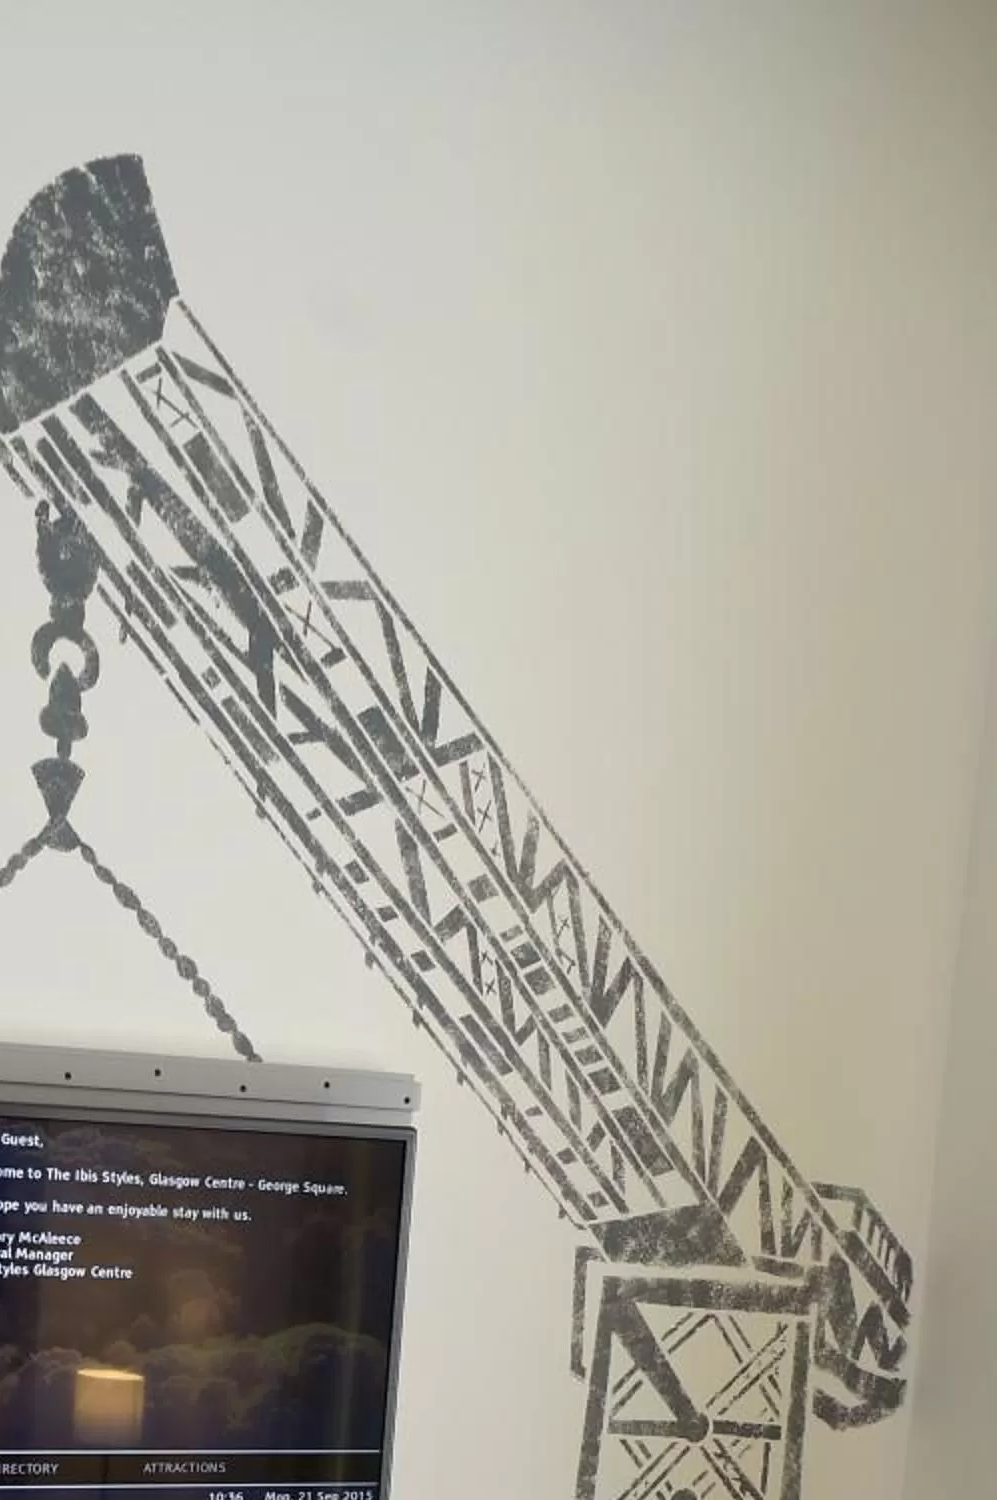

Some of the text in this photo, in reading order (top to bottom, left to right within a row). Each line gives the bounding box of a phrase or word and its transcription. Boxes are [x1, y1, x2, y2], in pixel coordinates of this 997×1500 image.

[1, 1133, 44, 1149] Guest,
[27, 1166, 42, 1180] to
[46, 1167, 71, 1182] The
[75, 1169, 98, 1183] Ibis
[102, 1171, 145, 1188] Styles,
[149, 1172, 200, 1189] Glasgow
[204, 1176, 245, 1190] Centre
[258, 1179, 300, 1195] George
[303, 1181, 348, 1197] Square.
[24, 1202, 48, 1217] you
[52, 1200, 83, 1215] have
[87, 1205, 104, 1216] an
[108, 1203, 168, 1220] enjoyable
[172, 1207, 198, 1222] stay
[202, 1207, 230, 1219] with
[233, 1210, 252, 1221] us.
[18, 1231, 82, 1246] McAleece
[15, 1248, 74, 1263] Manager
[33, 1265, 87, 1281] Glasgow
[91, 1265, 133, 1280] Centre
[143, 1461, 227, 1475] ATTRACTIONS
